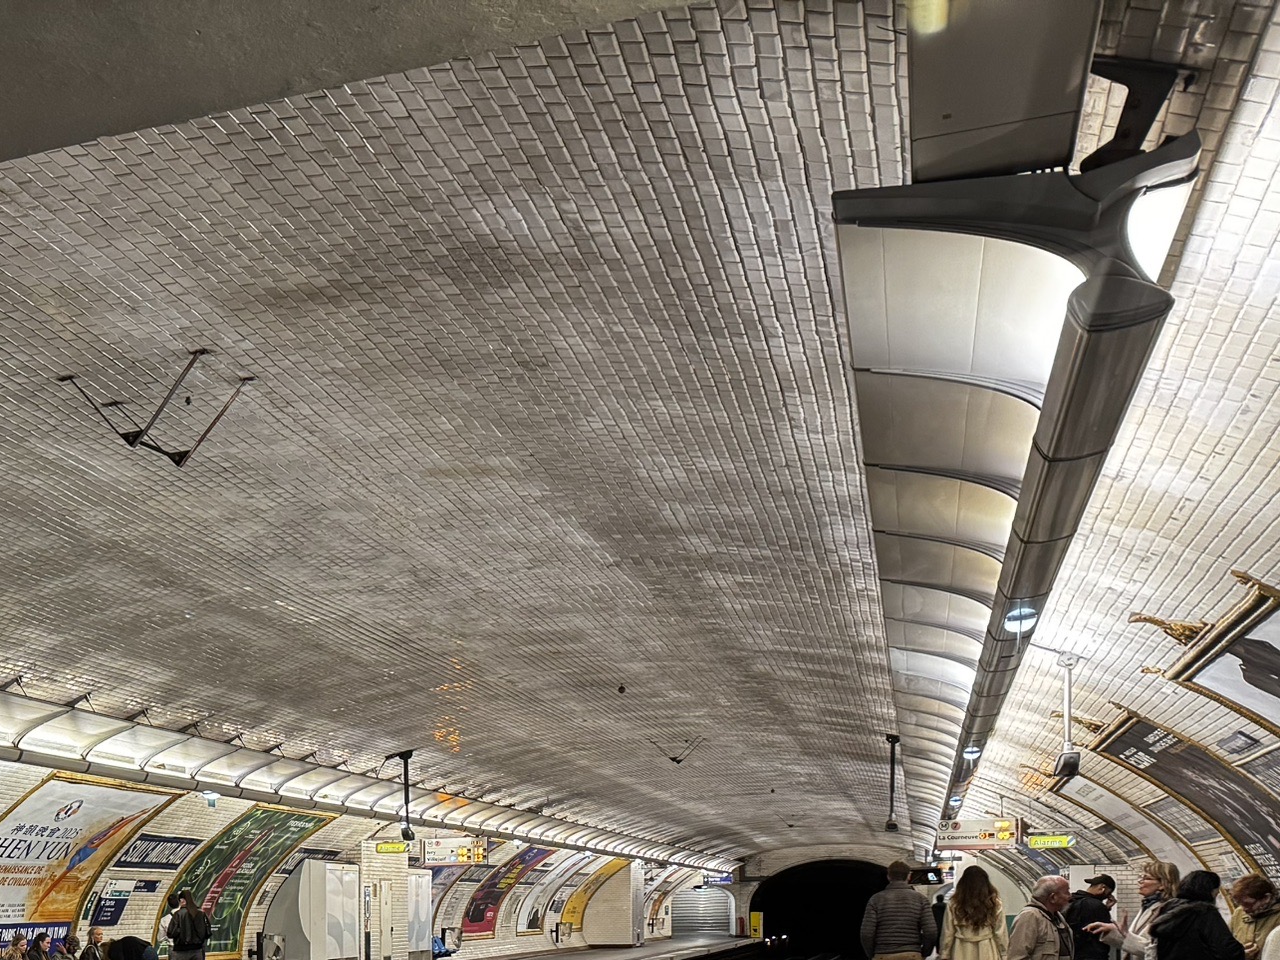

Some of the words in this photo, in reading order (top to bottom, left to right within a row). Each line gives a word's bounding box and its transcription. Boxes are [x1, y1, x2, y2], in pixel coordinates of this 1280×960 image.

[35, 840, 79, 861] YUN
[120, 840, 196, 864] SULLY-MORLAND
[36, 866, 44, 874] DE
[0, 877, 9, 885] DE
[9, 876, 45, 886] CIVILISATION
[1, 928, 16, 941] PARIS
